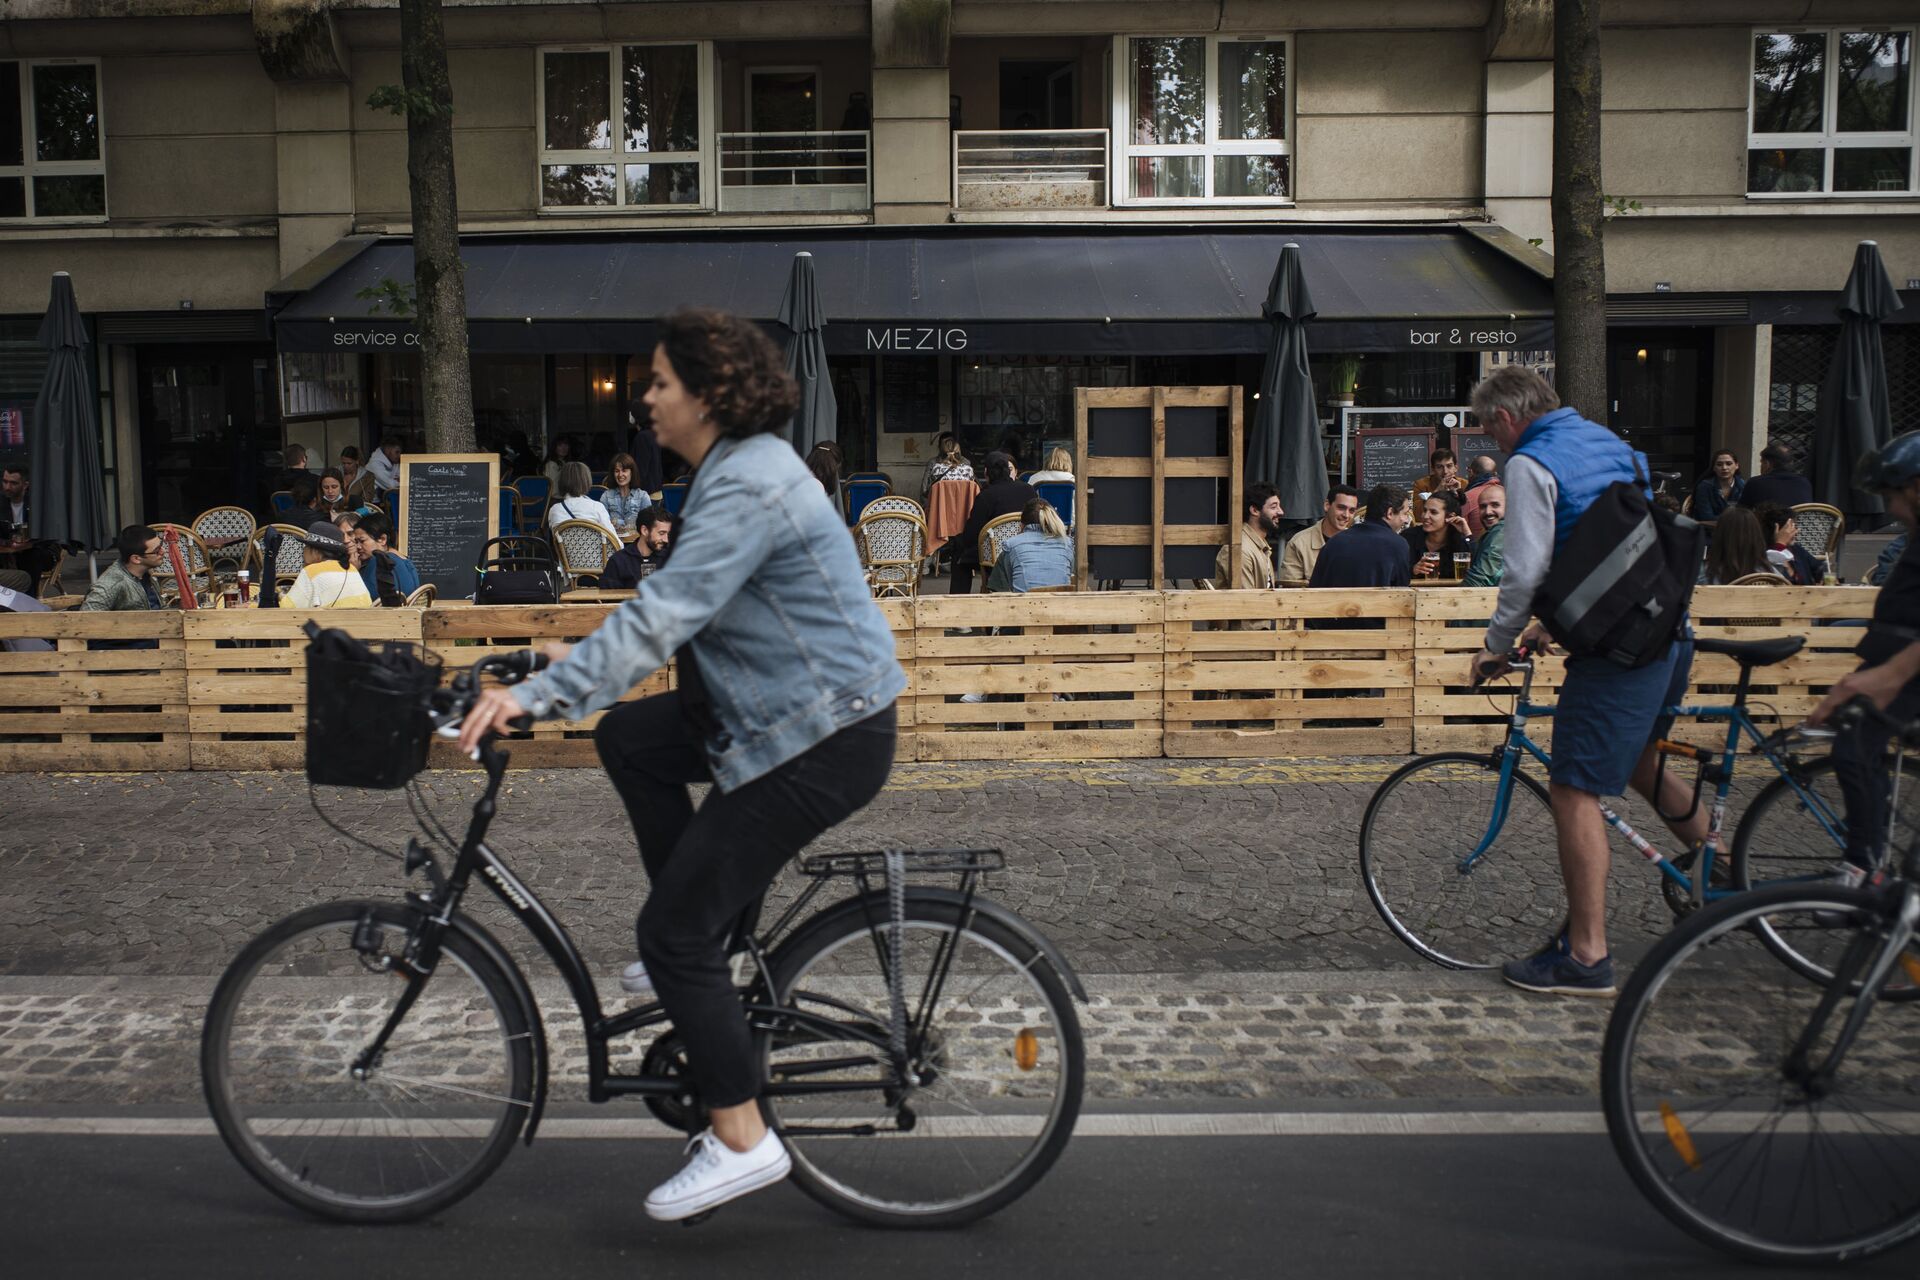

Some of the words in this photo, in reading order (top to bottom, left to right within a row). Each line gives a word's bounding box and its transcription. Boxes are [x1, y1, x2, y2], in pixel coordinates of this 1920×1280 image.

[333, 329, 397, 346] service
[866, 328, 967, 350] MEZIG
[1410, 329, 1442, 345] bar
[1449, 328, 1462, 344] &
[1470, 329, 1517, 344] resto
